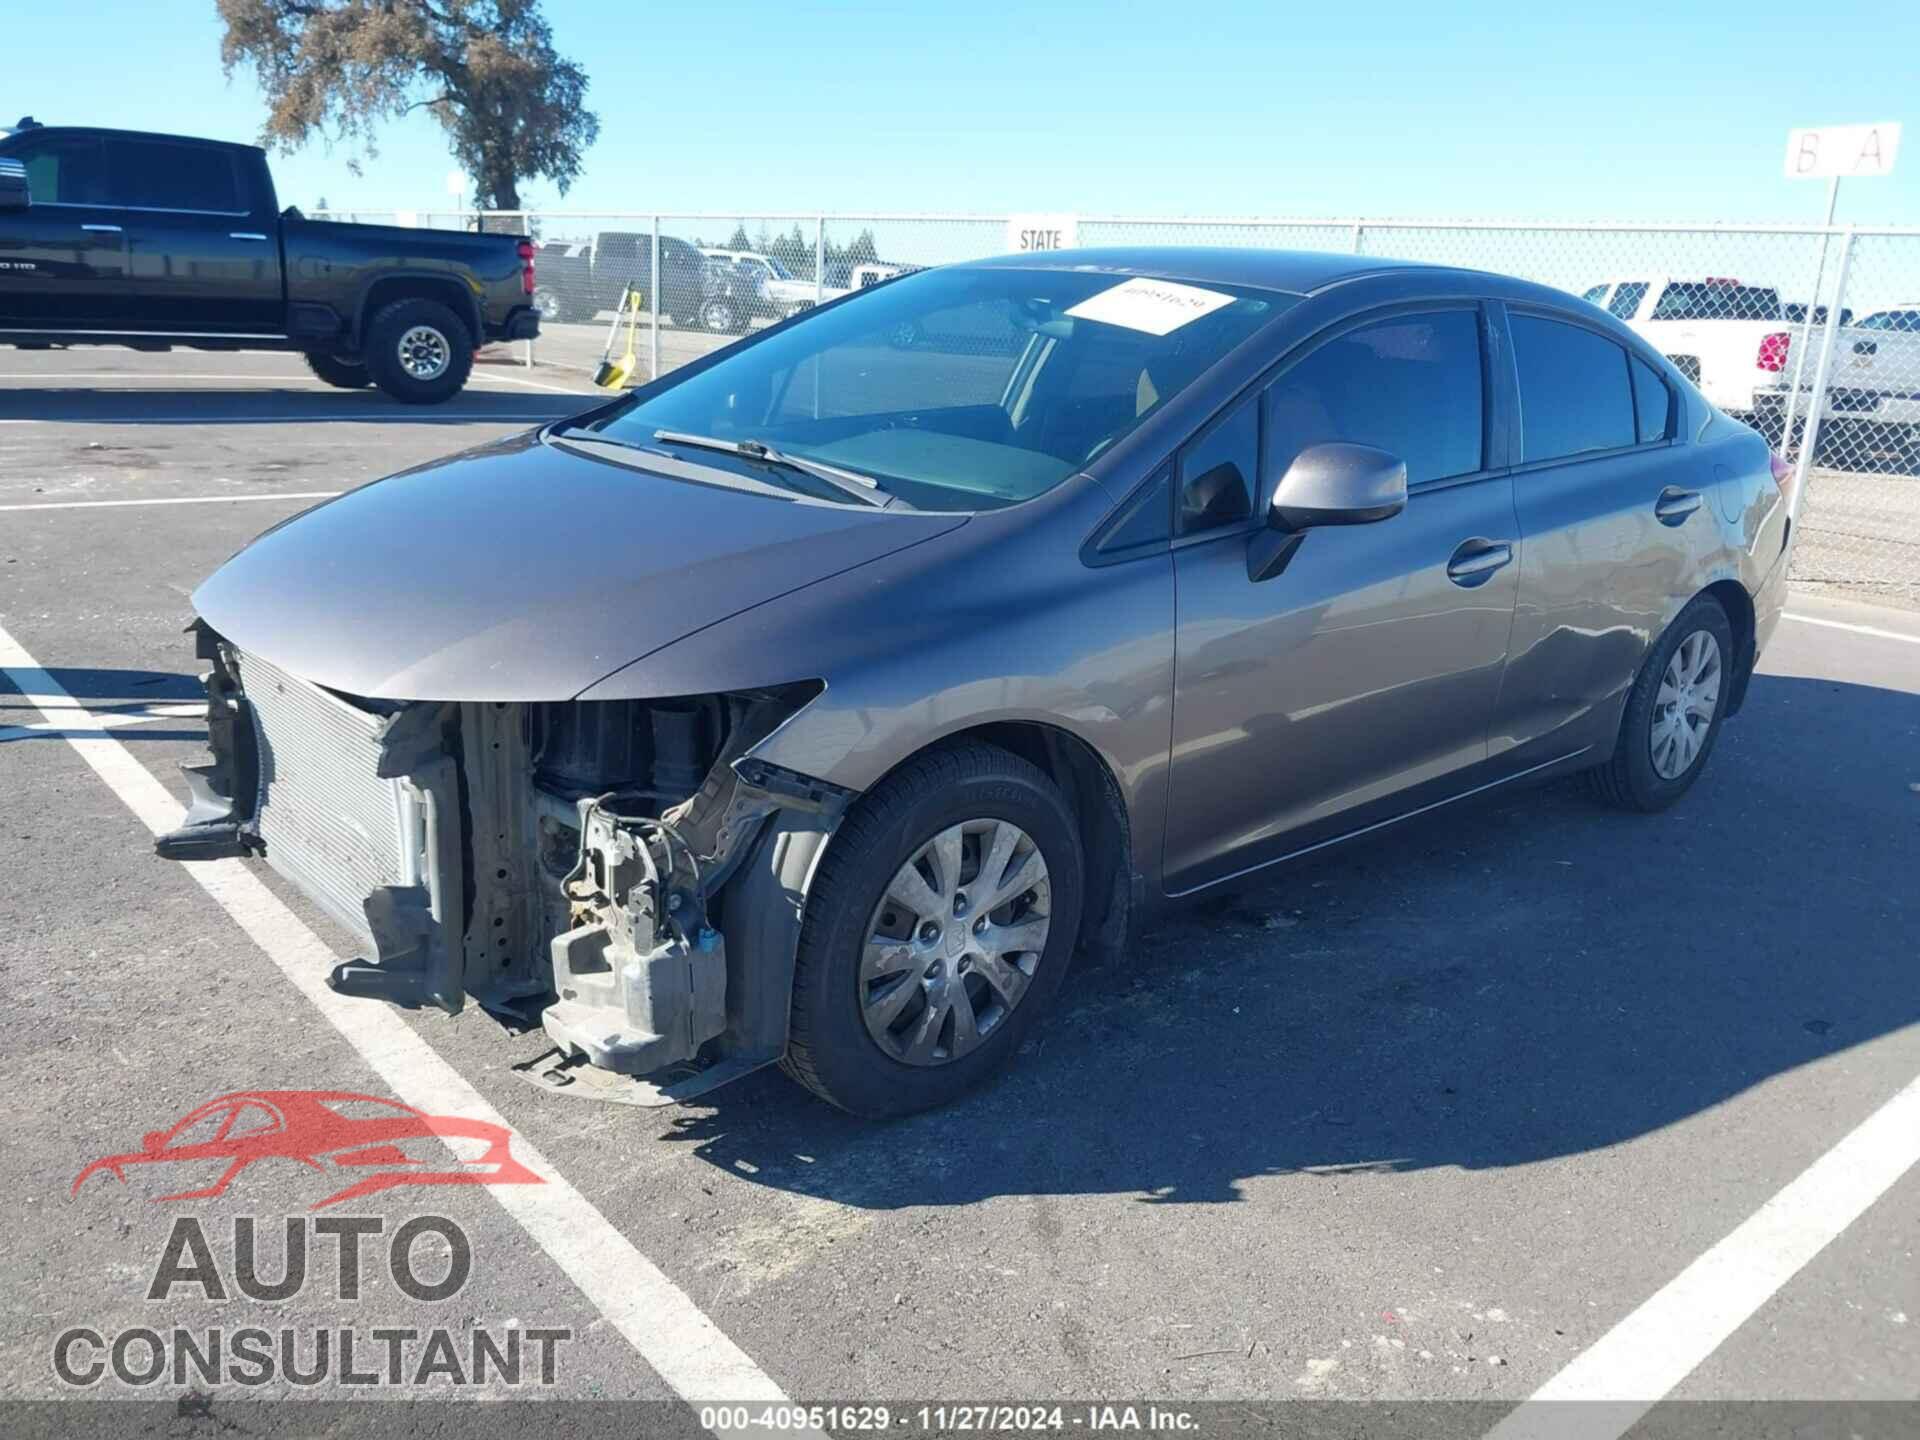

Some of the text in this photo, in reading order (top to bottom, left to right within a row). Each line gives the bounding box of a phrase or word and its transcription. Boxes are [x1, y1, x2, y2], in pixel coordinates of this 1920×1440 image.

[1796, 128, 1882, 173] B A
[1020, 229, 1062, 250] STATE
